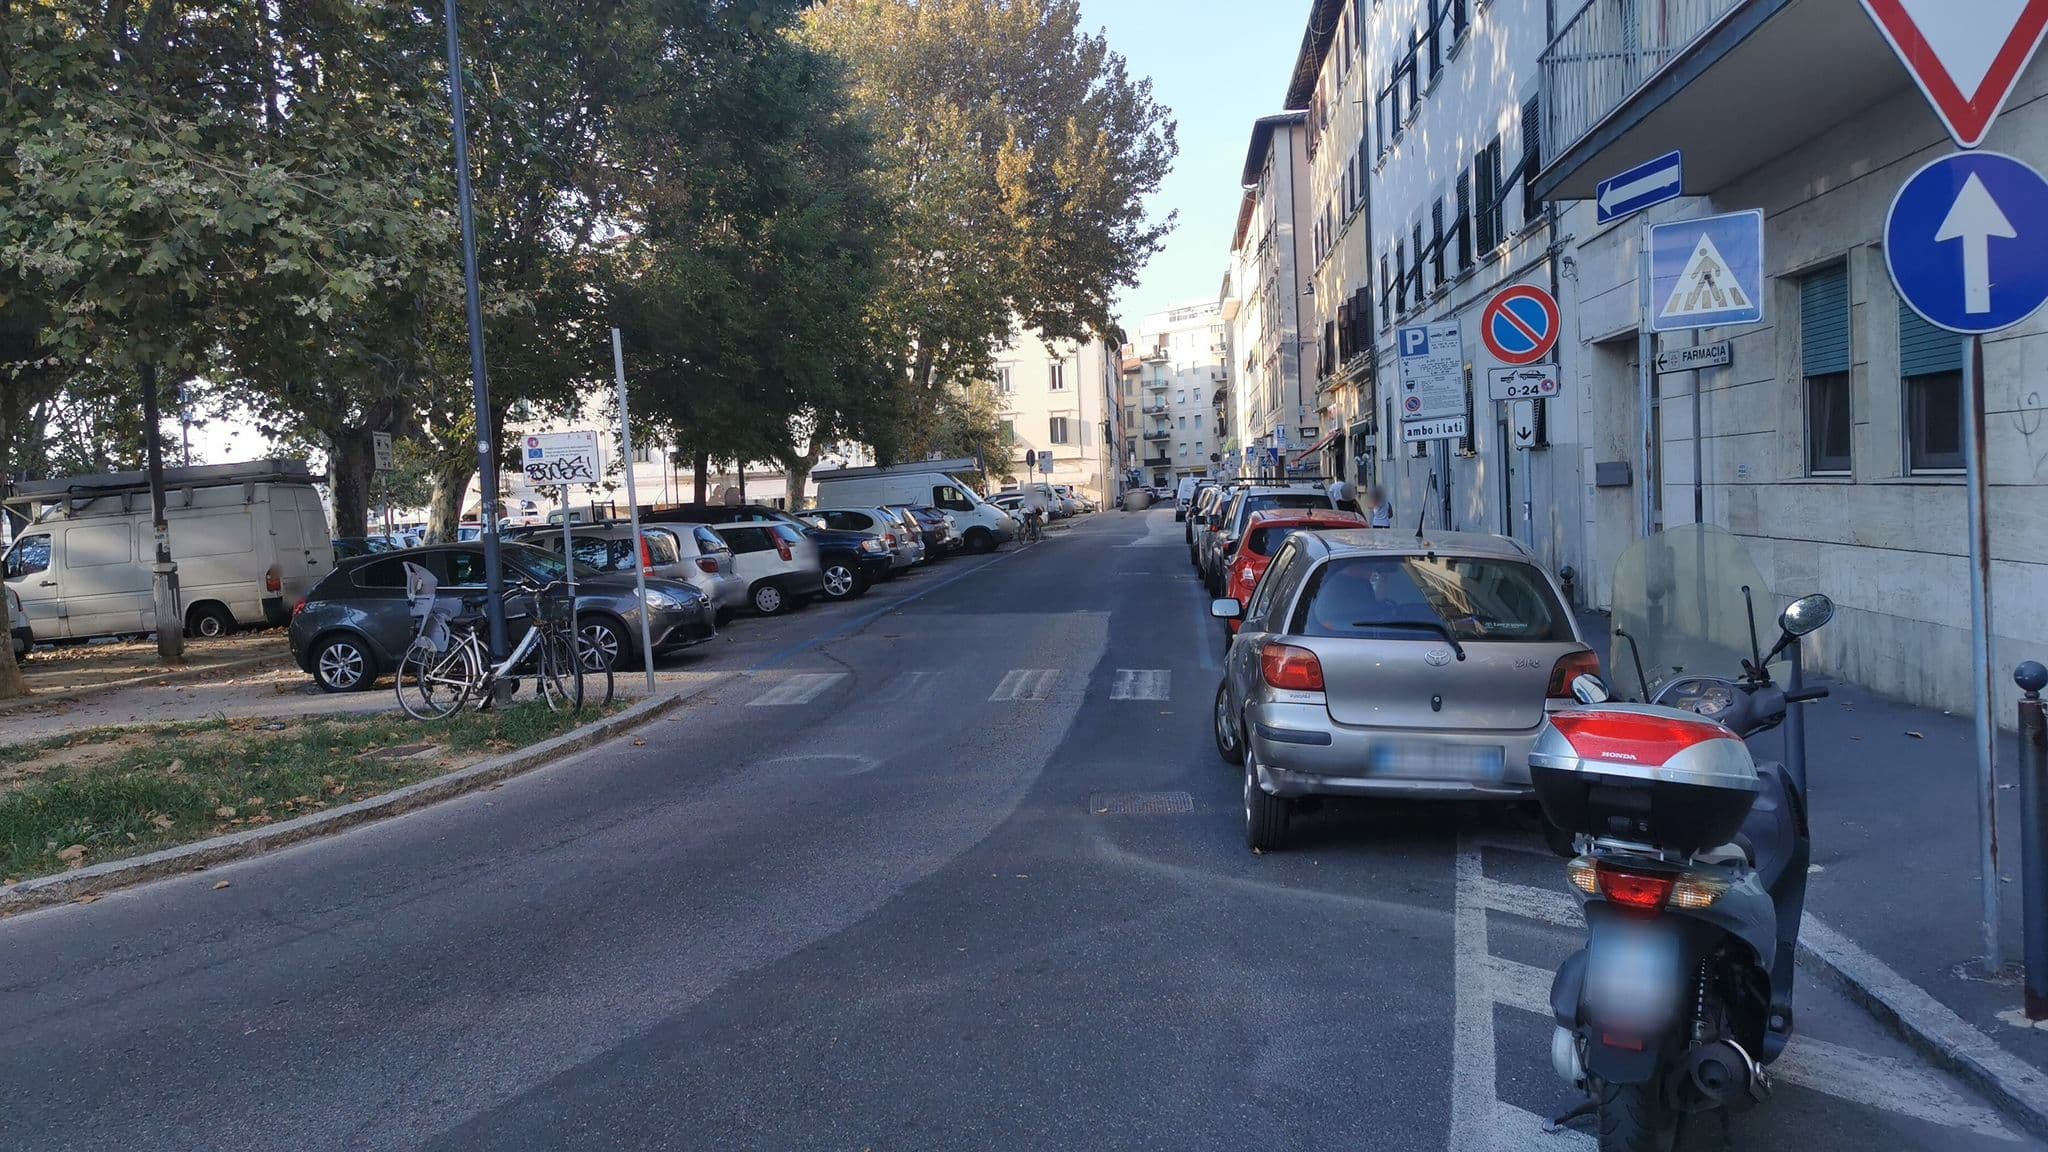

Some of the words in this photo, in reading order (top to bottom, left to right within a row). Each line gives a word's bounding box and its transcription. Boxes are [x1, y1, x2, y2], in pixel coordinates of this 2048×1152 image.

[1405, 329, 1425, 355] P
[1682, 345, 1726, 361] FARMACIA
[1407, 425, 1433, 437] ambo
[1436, 423, 1440, 434] i
[1443, 422, 1462, 434] lati
[1601, 751, 1638, 761] HONDA
